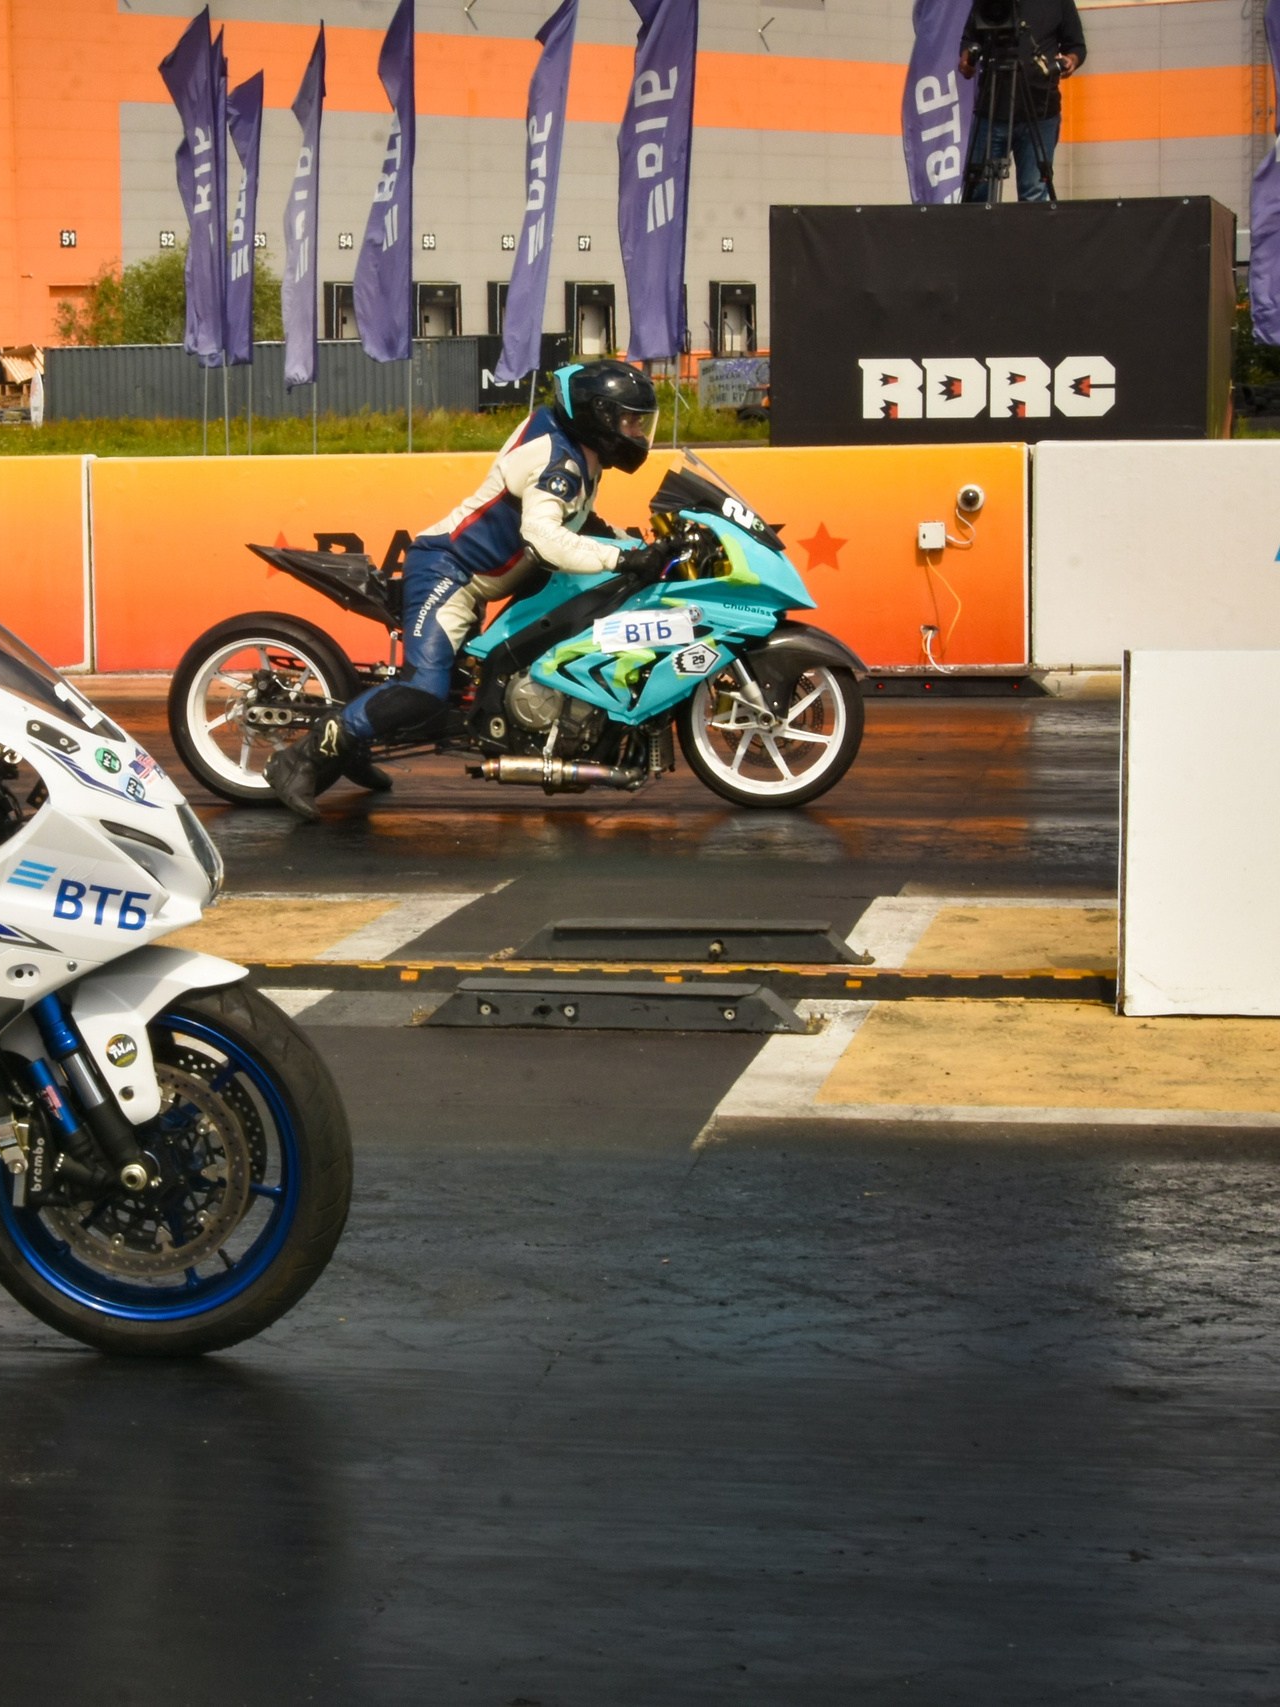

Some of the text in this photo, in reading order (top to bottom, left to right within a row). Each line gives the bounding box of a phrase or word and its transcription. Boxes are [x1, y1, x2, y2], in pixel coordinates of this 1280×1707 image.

[858, 356, 1116, 419] RDRC
[625, 620, 673, 644] ВТБ
[692, 654, 706, 666] 29
[53, 879, 152, 931] ВТБ
[30, 1137, 45, 1192] brembo
